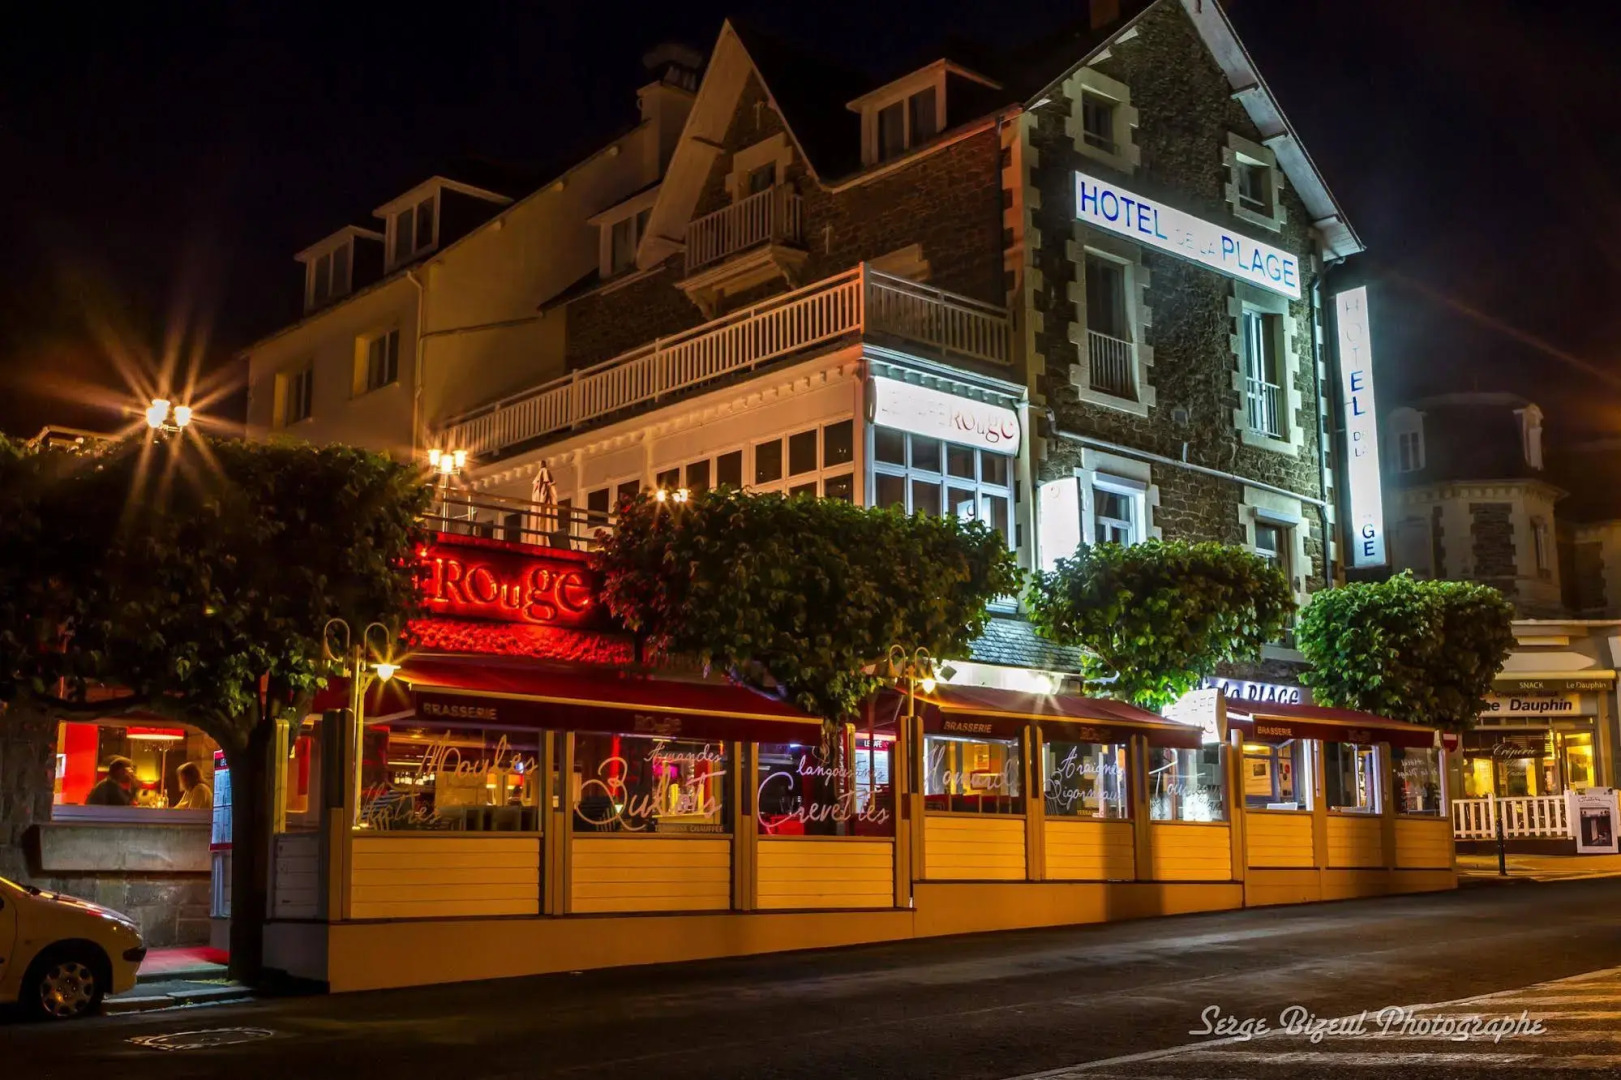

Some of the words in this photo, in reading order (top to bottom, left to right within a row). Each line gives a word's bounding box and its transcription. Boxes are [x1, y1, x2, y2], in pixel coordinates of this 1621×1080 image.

[1081, 181, 1168, 240] HOTEL
[1221, 235, 1296, 288] PLAGE
[1345, 299, 1366, 416] HOTEL
[1575, 681, 1607, 690] Dauphin
[423, 702, 498, 721] BRASSERIE
[1510, 698, 1572, 713] Dauphin
[944, 720, 992, 734] BRASSERIE
[1257, 725, 1293, 737] BRASSERIE
[413, 730, 538, 779] Moules
[574, 756, 728, 831] Bulots
